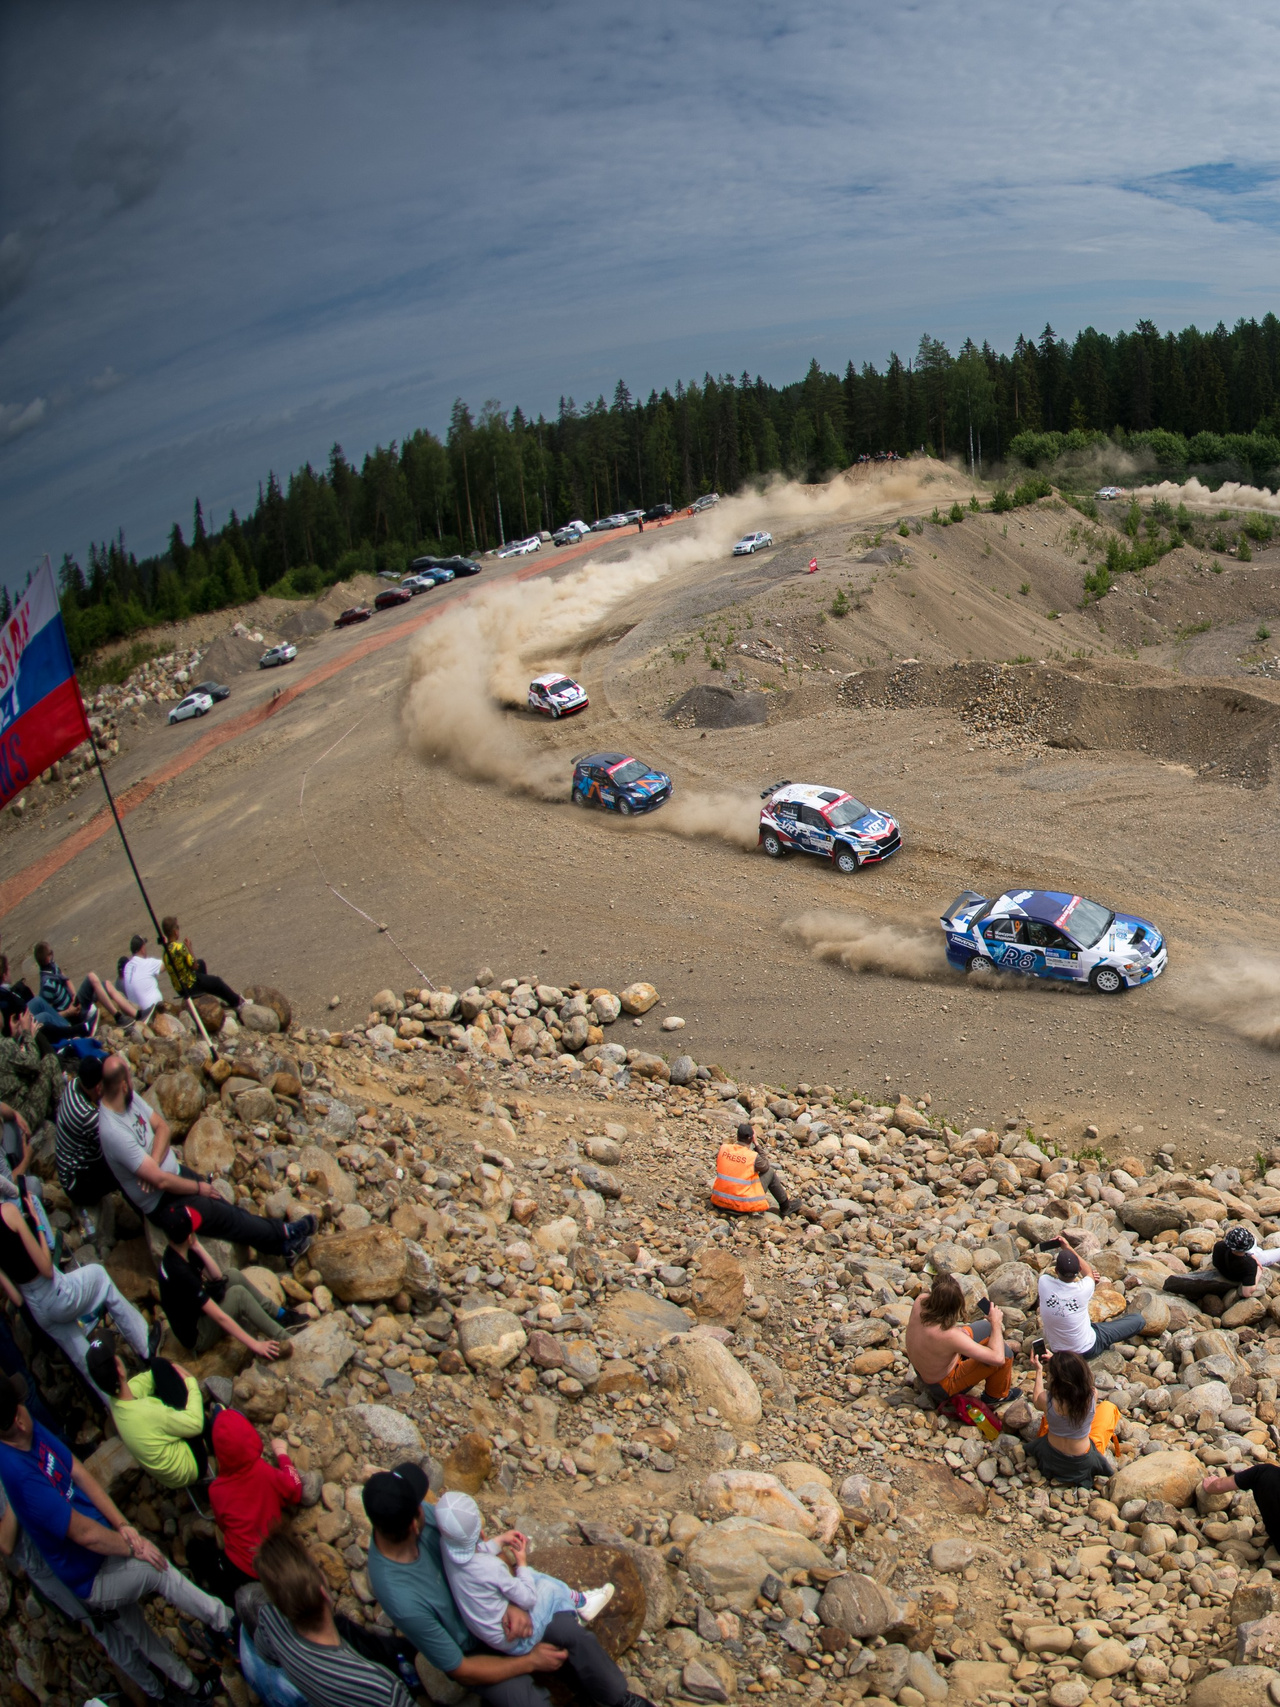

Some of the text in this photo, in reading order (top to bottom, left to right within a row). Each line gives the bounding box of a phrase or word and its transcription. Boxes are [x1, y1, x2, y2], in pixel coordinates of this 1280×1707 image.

[864, 819, 886, 834] VRT
[1014, 920, 1020, 932] 9
[999, 946, 1037, 970] R8
[722, 1151, 747, 1164] PRESS
